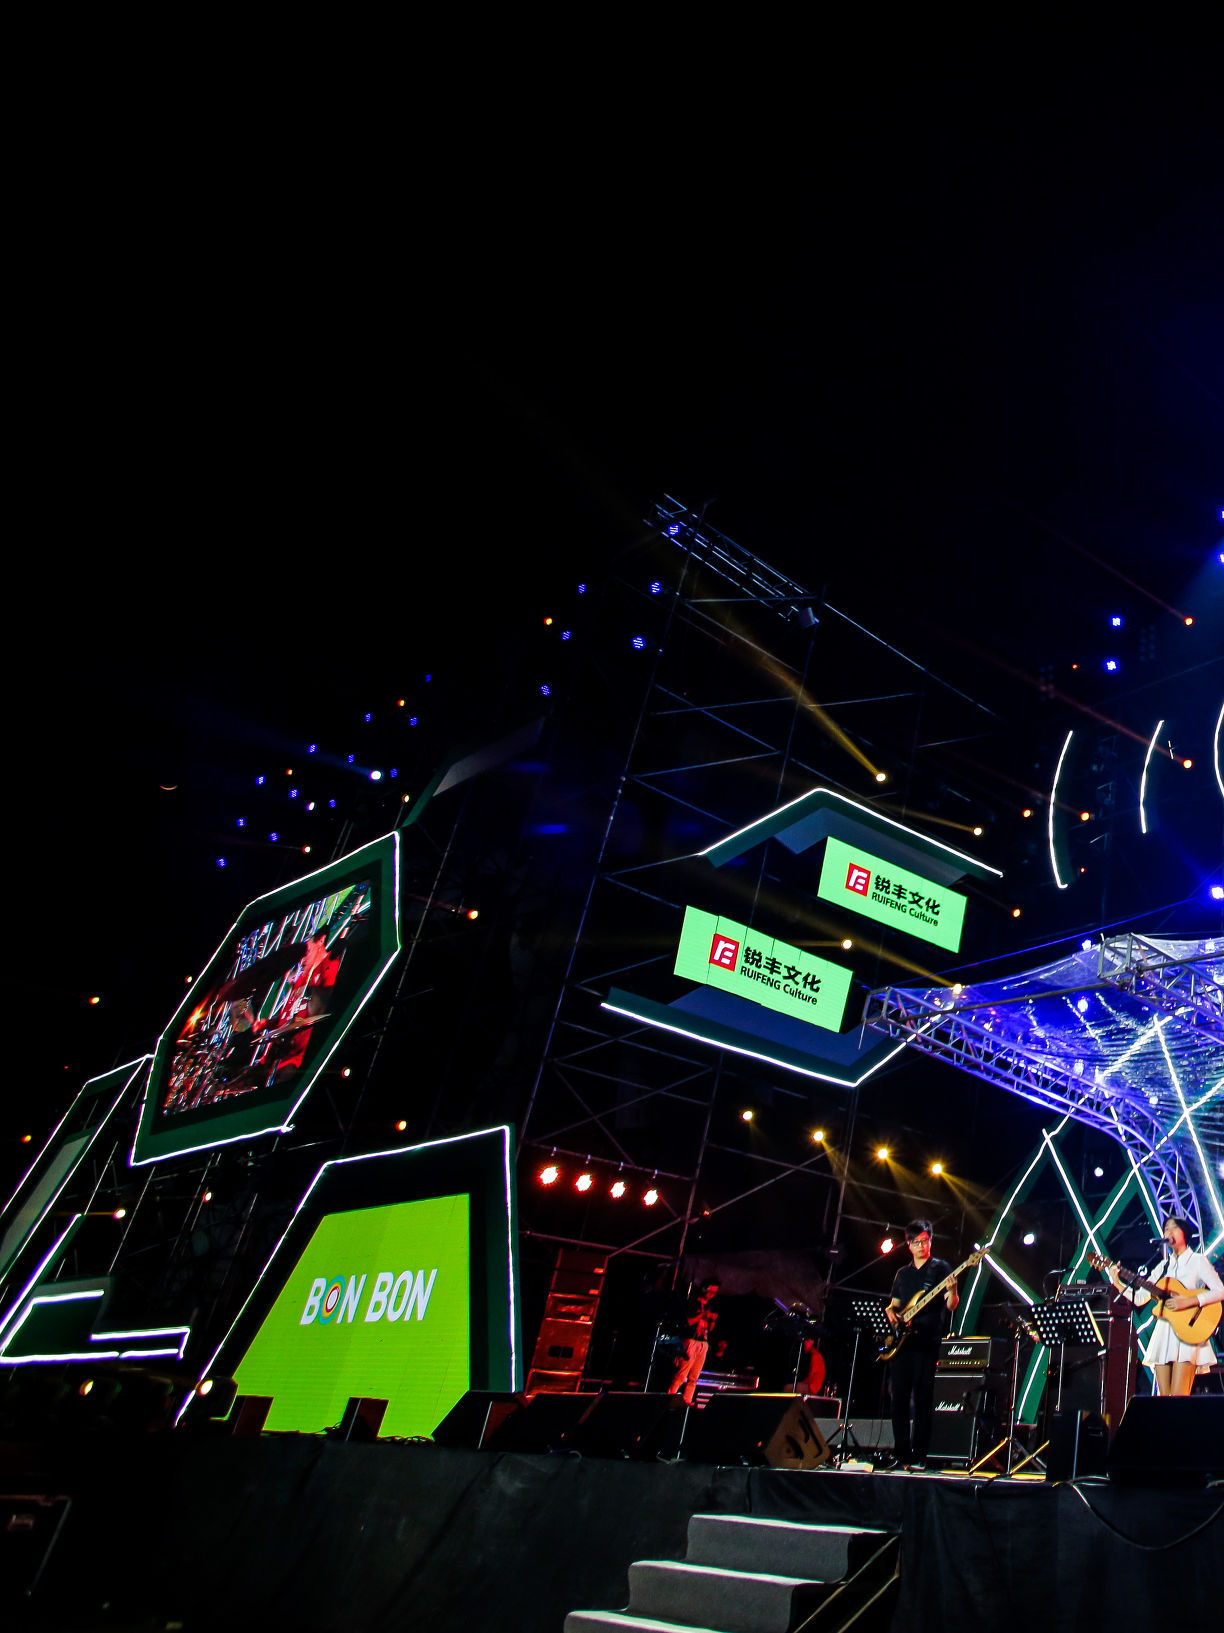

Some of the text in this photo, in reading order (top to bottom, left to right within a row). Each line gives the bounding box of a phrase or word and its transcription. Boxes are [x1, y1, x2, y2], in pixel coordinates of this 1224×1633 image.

[871, 891, 939, 926] RUIFENG Culture
[874, 874, 941, 916] 锐丰文化
[740, 965, 818, 1005] RUIFENG Culture
[743, 946, 822, 993] 锐丰文化
